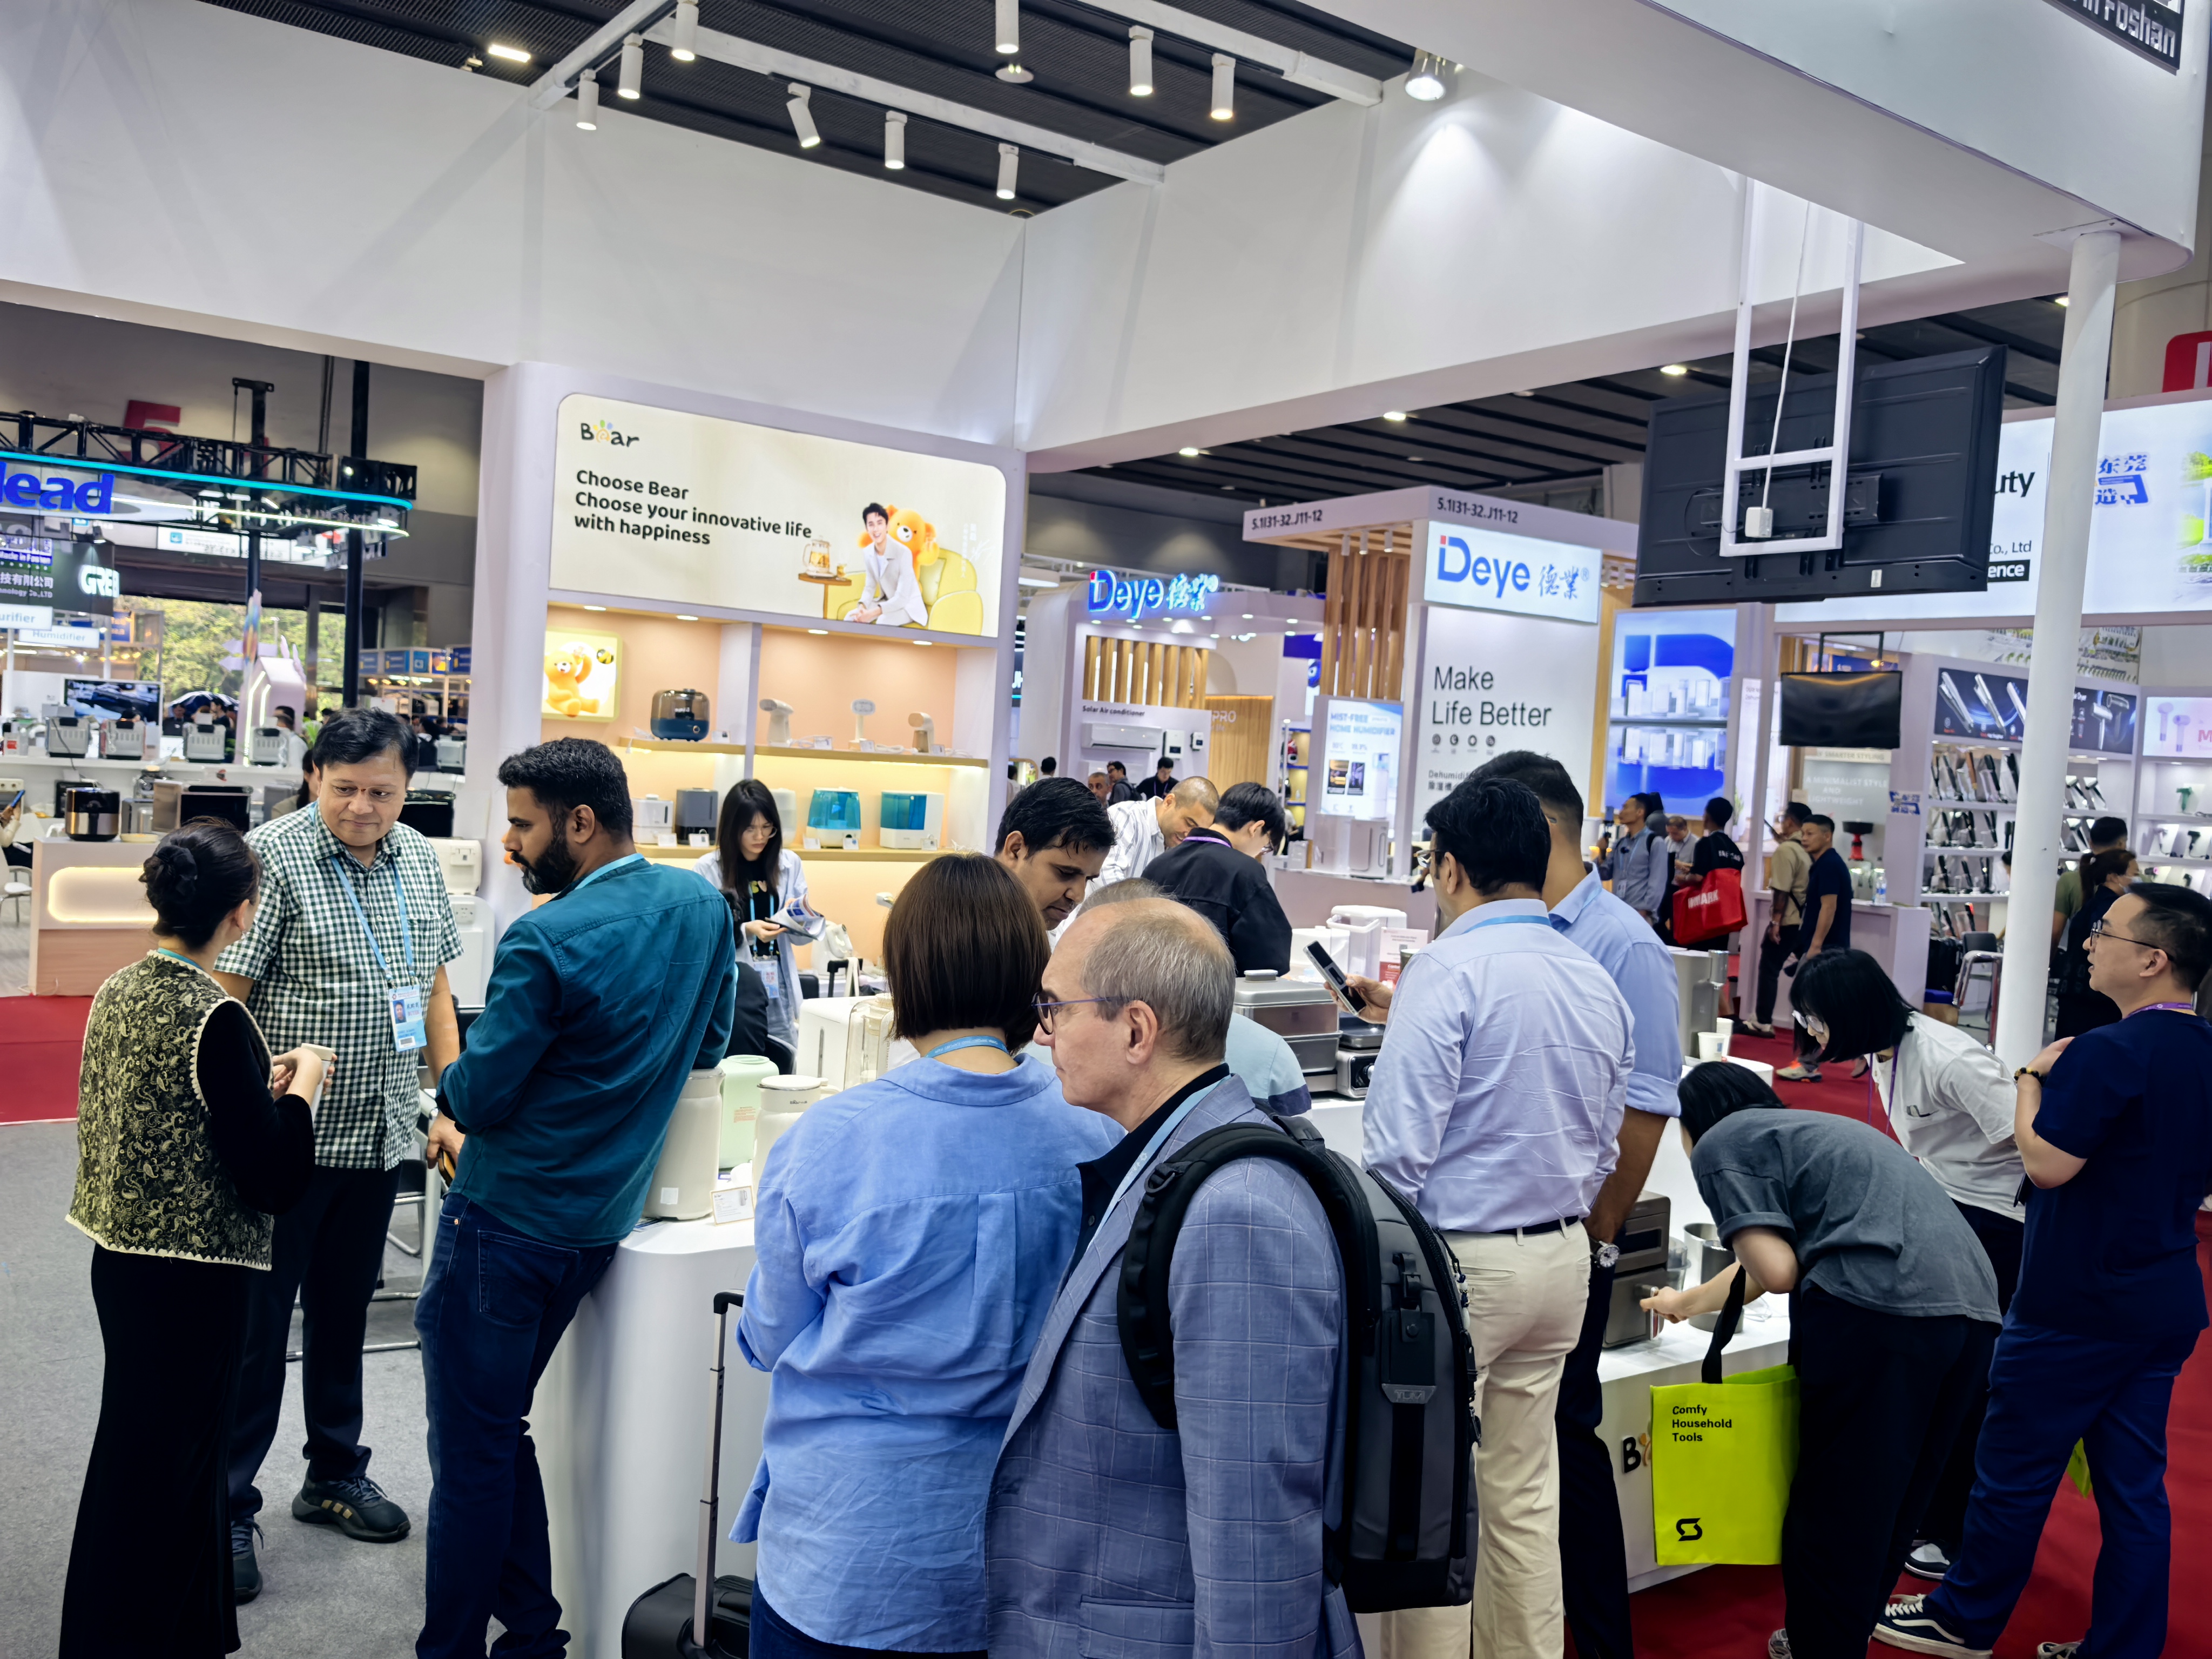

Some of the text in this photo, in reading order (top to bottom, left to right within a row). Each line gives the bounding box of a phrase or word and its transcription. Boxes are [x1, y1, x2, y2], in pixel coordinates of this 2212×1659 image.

[576, 470, 689, 500] Choose Bear
[575, 491, 812, 538] Choose your innovative life
[575, 514, 710, 545] with happiness
[2012, 541, 2032, 554] Ltd
[1438, 535, 1530, 598] Deye
[1987, 563, 2025, 578] ence
[1088, 570, 1164, 619] Deye
[32, 630, 85, 642] Humidifier
[1434, 665, 1493, 690] Make
[1110, 709, 1145, 717] conditioner
[1432, 700, 1552, 726] Life Better
[1813, 777, 1862, 786] MINIMALIST
[1863, 778, 1887, 788] STYLE
[1823, 786, 1841, 795] AND
[1672, 1405, 1708, 1415] Comfy
[1672, 1418, 1732, 1429] Household
[1672, 1432, 1703, 1442] Tools
